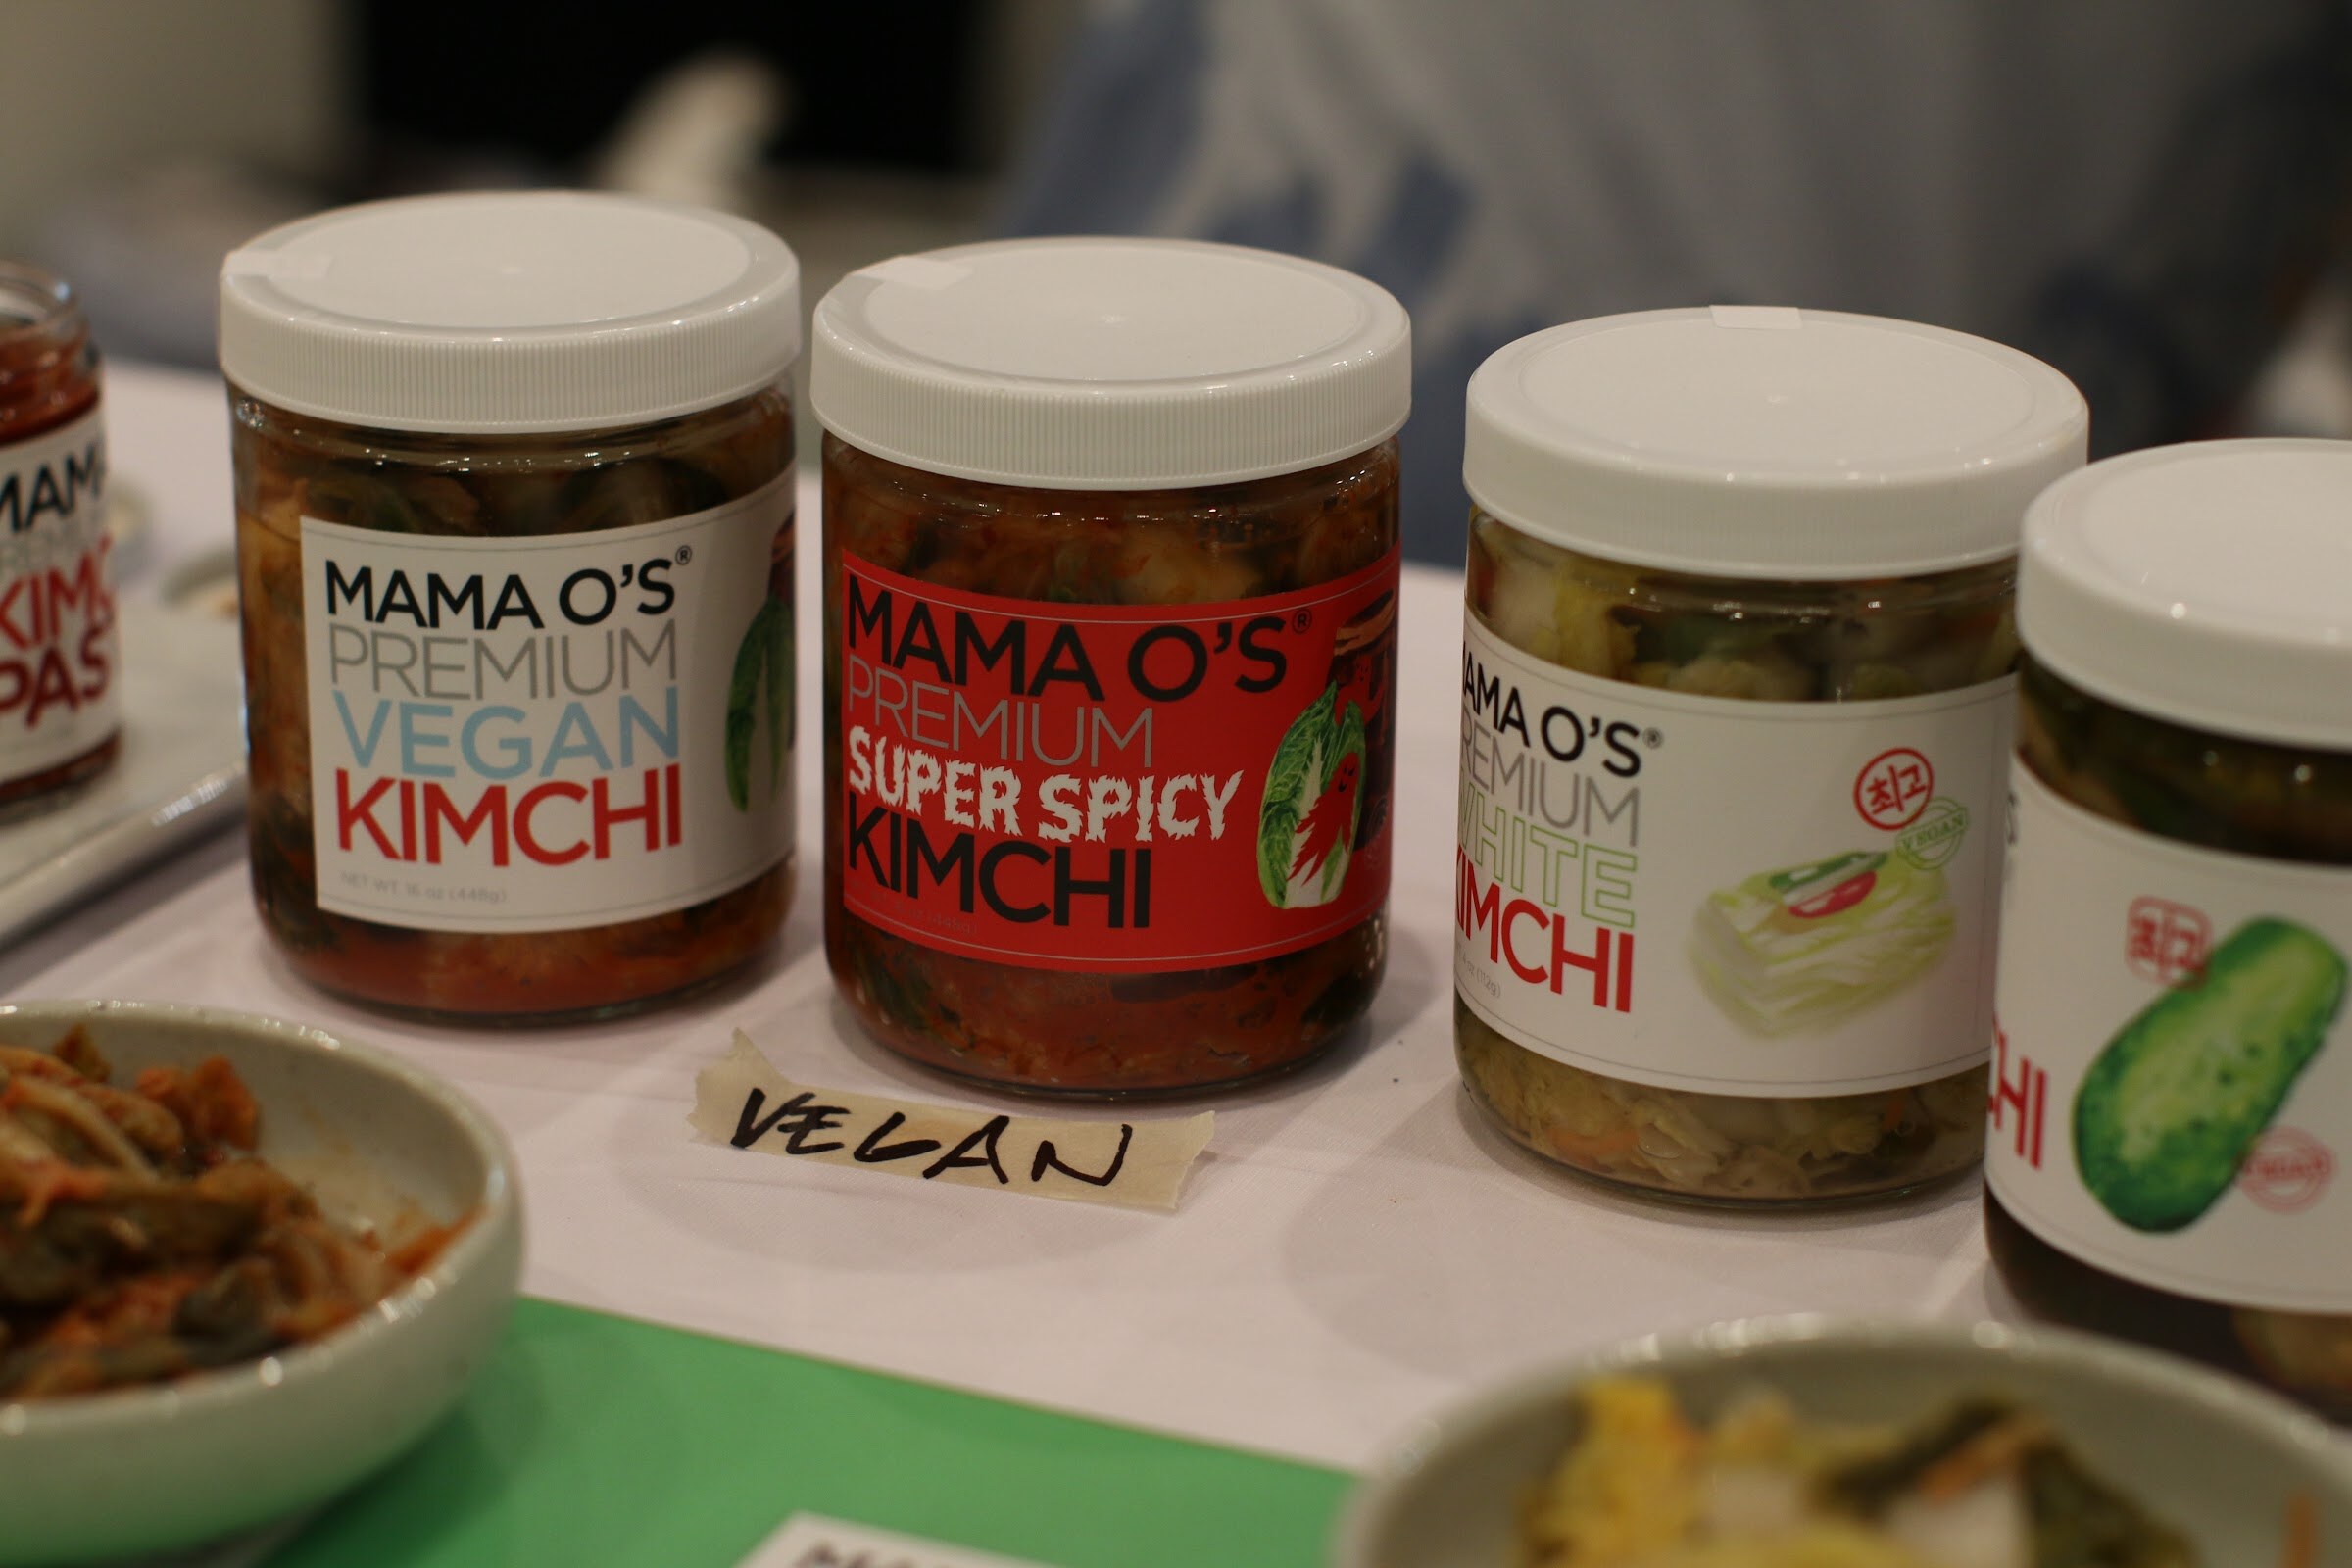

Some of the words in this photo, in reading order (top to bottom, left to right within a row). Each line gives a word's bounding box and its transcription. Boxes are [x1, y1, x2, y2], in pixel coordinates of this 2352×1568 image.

[325, 560, 545, 631] MAMA
[849, 574, 1105, 702] MAMA
[0, 627, 111, 731] PAS
[329, 618, 677, 701] PREMIUM
[848, 654, 1153, 767] PREMIUM
[1463, 642, 1531, 749] AMA
[331, 687, 680, 779] VEGAN
[848, 725, 1022, 836] SUPER
[1037, 770, 1244, 844] SPICY
[1460, 704, 1639, 847] REMIUM
[336, 762, 682, 867] KIMCHI
[1866, 763, 1928, 815] 최고
[849, 793, 1152, 928] KIMCHI
[730, 1088, 1132, 1186] VEGAN
